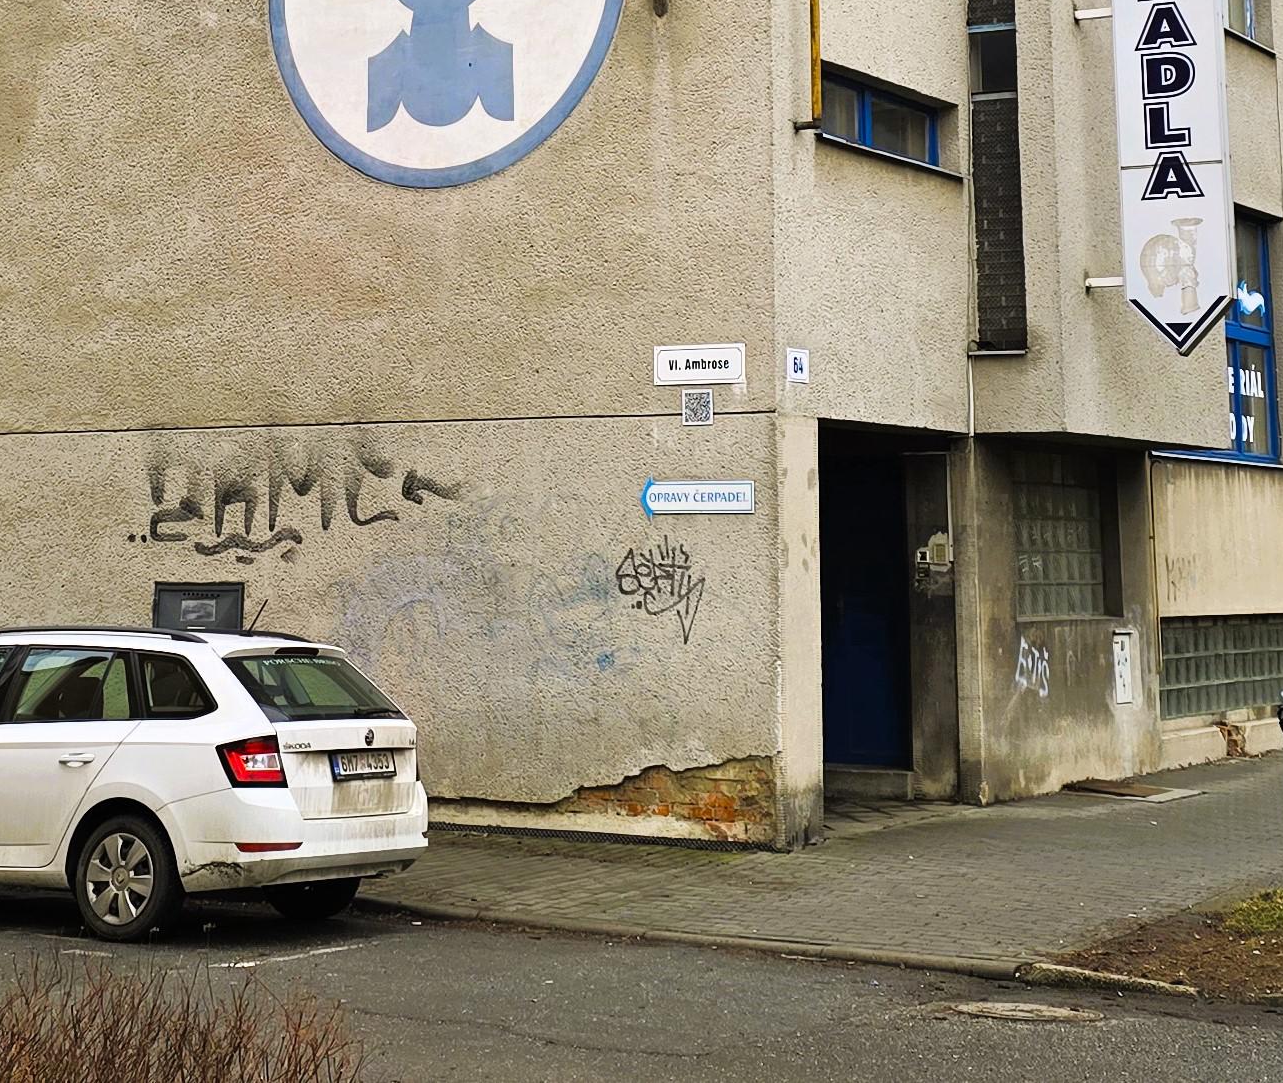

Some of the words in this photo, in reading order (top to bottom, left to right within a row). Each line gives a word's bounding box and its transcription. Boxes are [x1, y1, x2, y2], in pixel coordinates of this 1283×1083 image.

[684, 358, 730, 371] Ambrose
[792, 357, 804, 375] 64
[649, 492, 690, 504] OPRAVY
[693, 489, 750, 504] ČERPADEL
[366, 753, 390, 771] 4353
